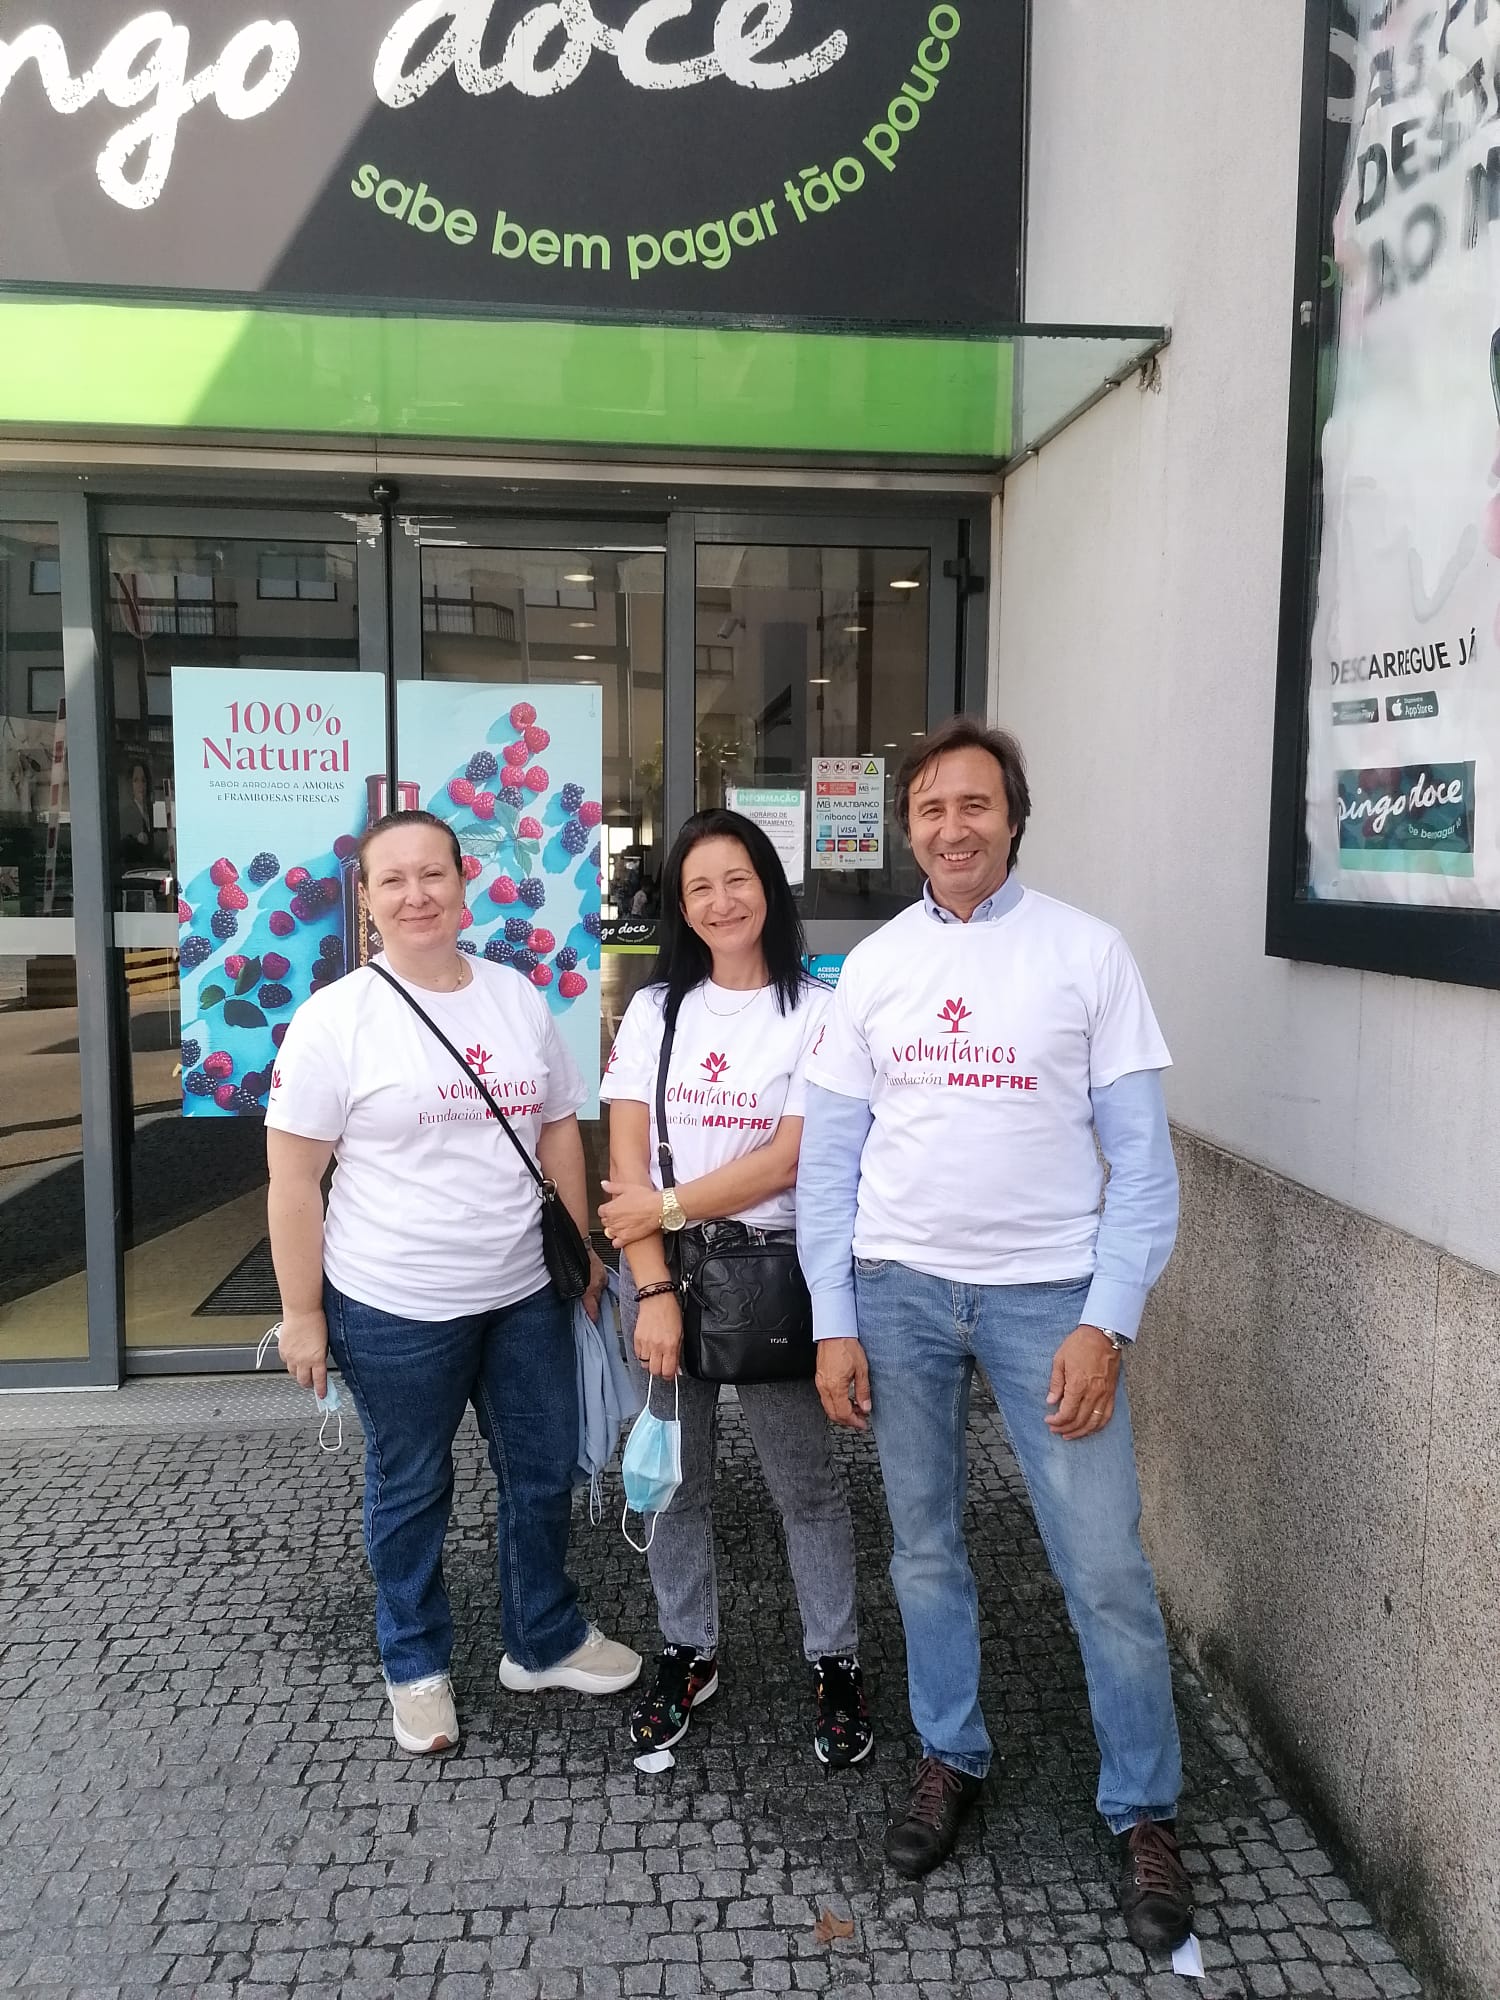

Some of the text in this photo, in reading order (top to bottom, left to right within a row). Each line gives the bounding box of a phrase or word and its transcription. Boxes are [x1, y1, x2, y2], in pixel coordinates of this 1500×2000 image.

[373, 0, 848, 108] doce
[351, 4, 961, 280] sabe bem pagar tão pouco
[1330, 627, 1478, 685] DESCARREGUE JÁ
[224, 701, 342, 736] 100%
[202, 737, 349, 772] Natural
[209, 780, 239, 788] SABOR
[242, 781, 290, 789] ARROJADO
[302, 781, 345, 790] AMORAS
[224, 793, 294, 802] FRAMBOESAS
[296, 794, 340, 803] FRESCAS
[1409, 772, 1463, 811] doce
[618, 922, 649, 934] doce
[892, 1037, 1017, 1063] voluntários
[947, 1072, 1039, 1090] MAPFRE
[667, 1081, 758, 1108] oluntários
[418, 1102, 544, 1124] Fundación MAPFRE
[702, 1115, 773, 1129] MAPFRE
